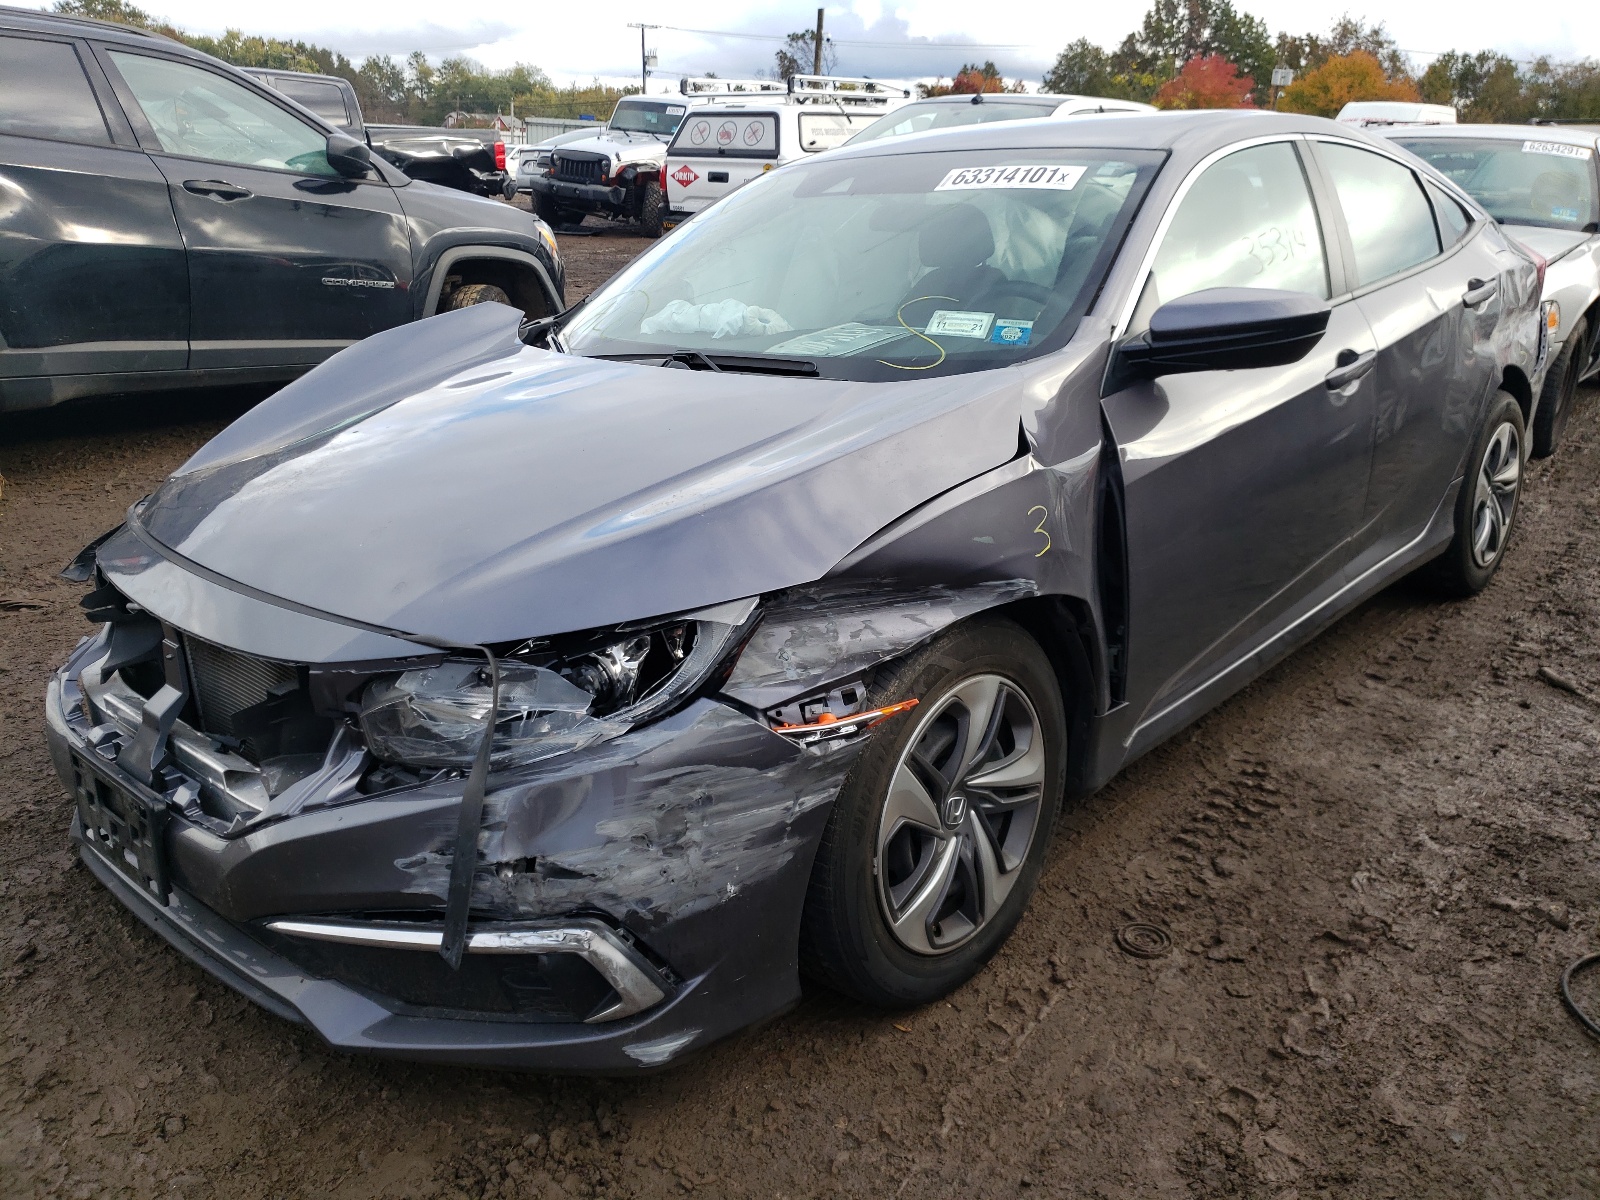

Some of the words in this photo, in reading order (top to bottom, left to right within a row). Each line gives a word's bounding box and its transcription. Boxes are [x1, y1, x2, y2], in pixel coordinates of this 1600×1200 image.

[674, 171, 695, 182] ORKIN
[951, 166, 1061, 186] 63314101
[321, 277, 395, 289] COMPASS
[970, 323, 984, 332] 21
[1026, 504, 1052, 558] 3
